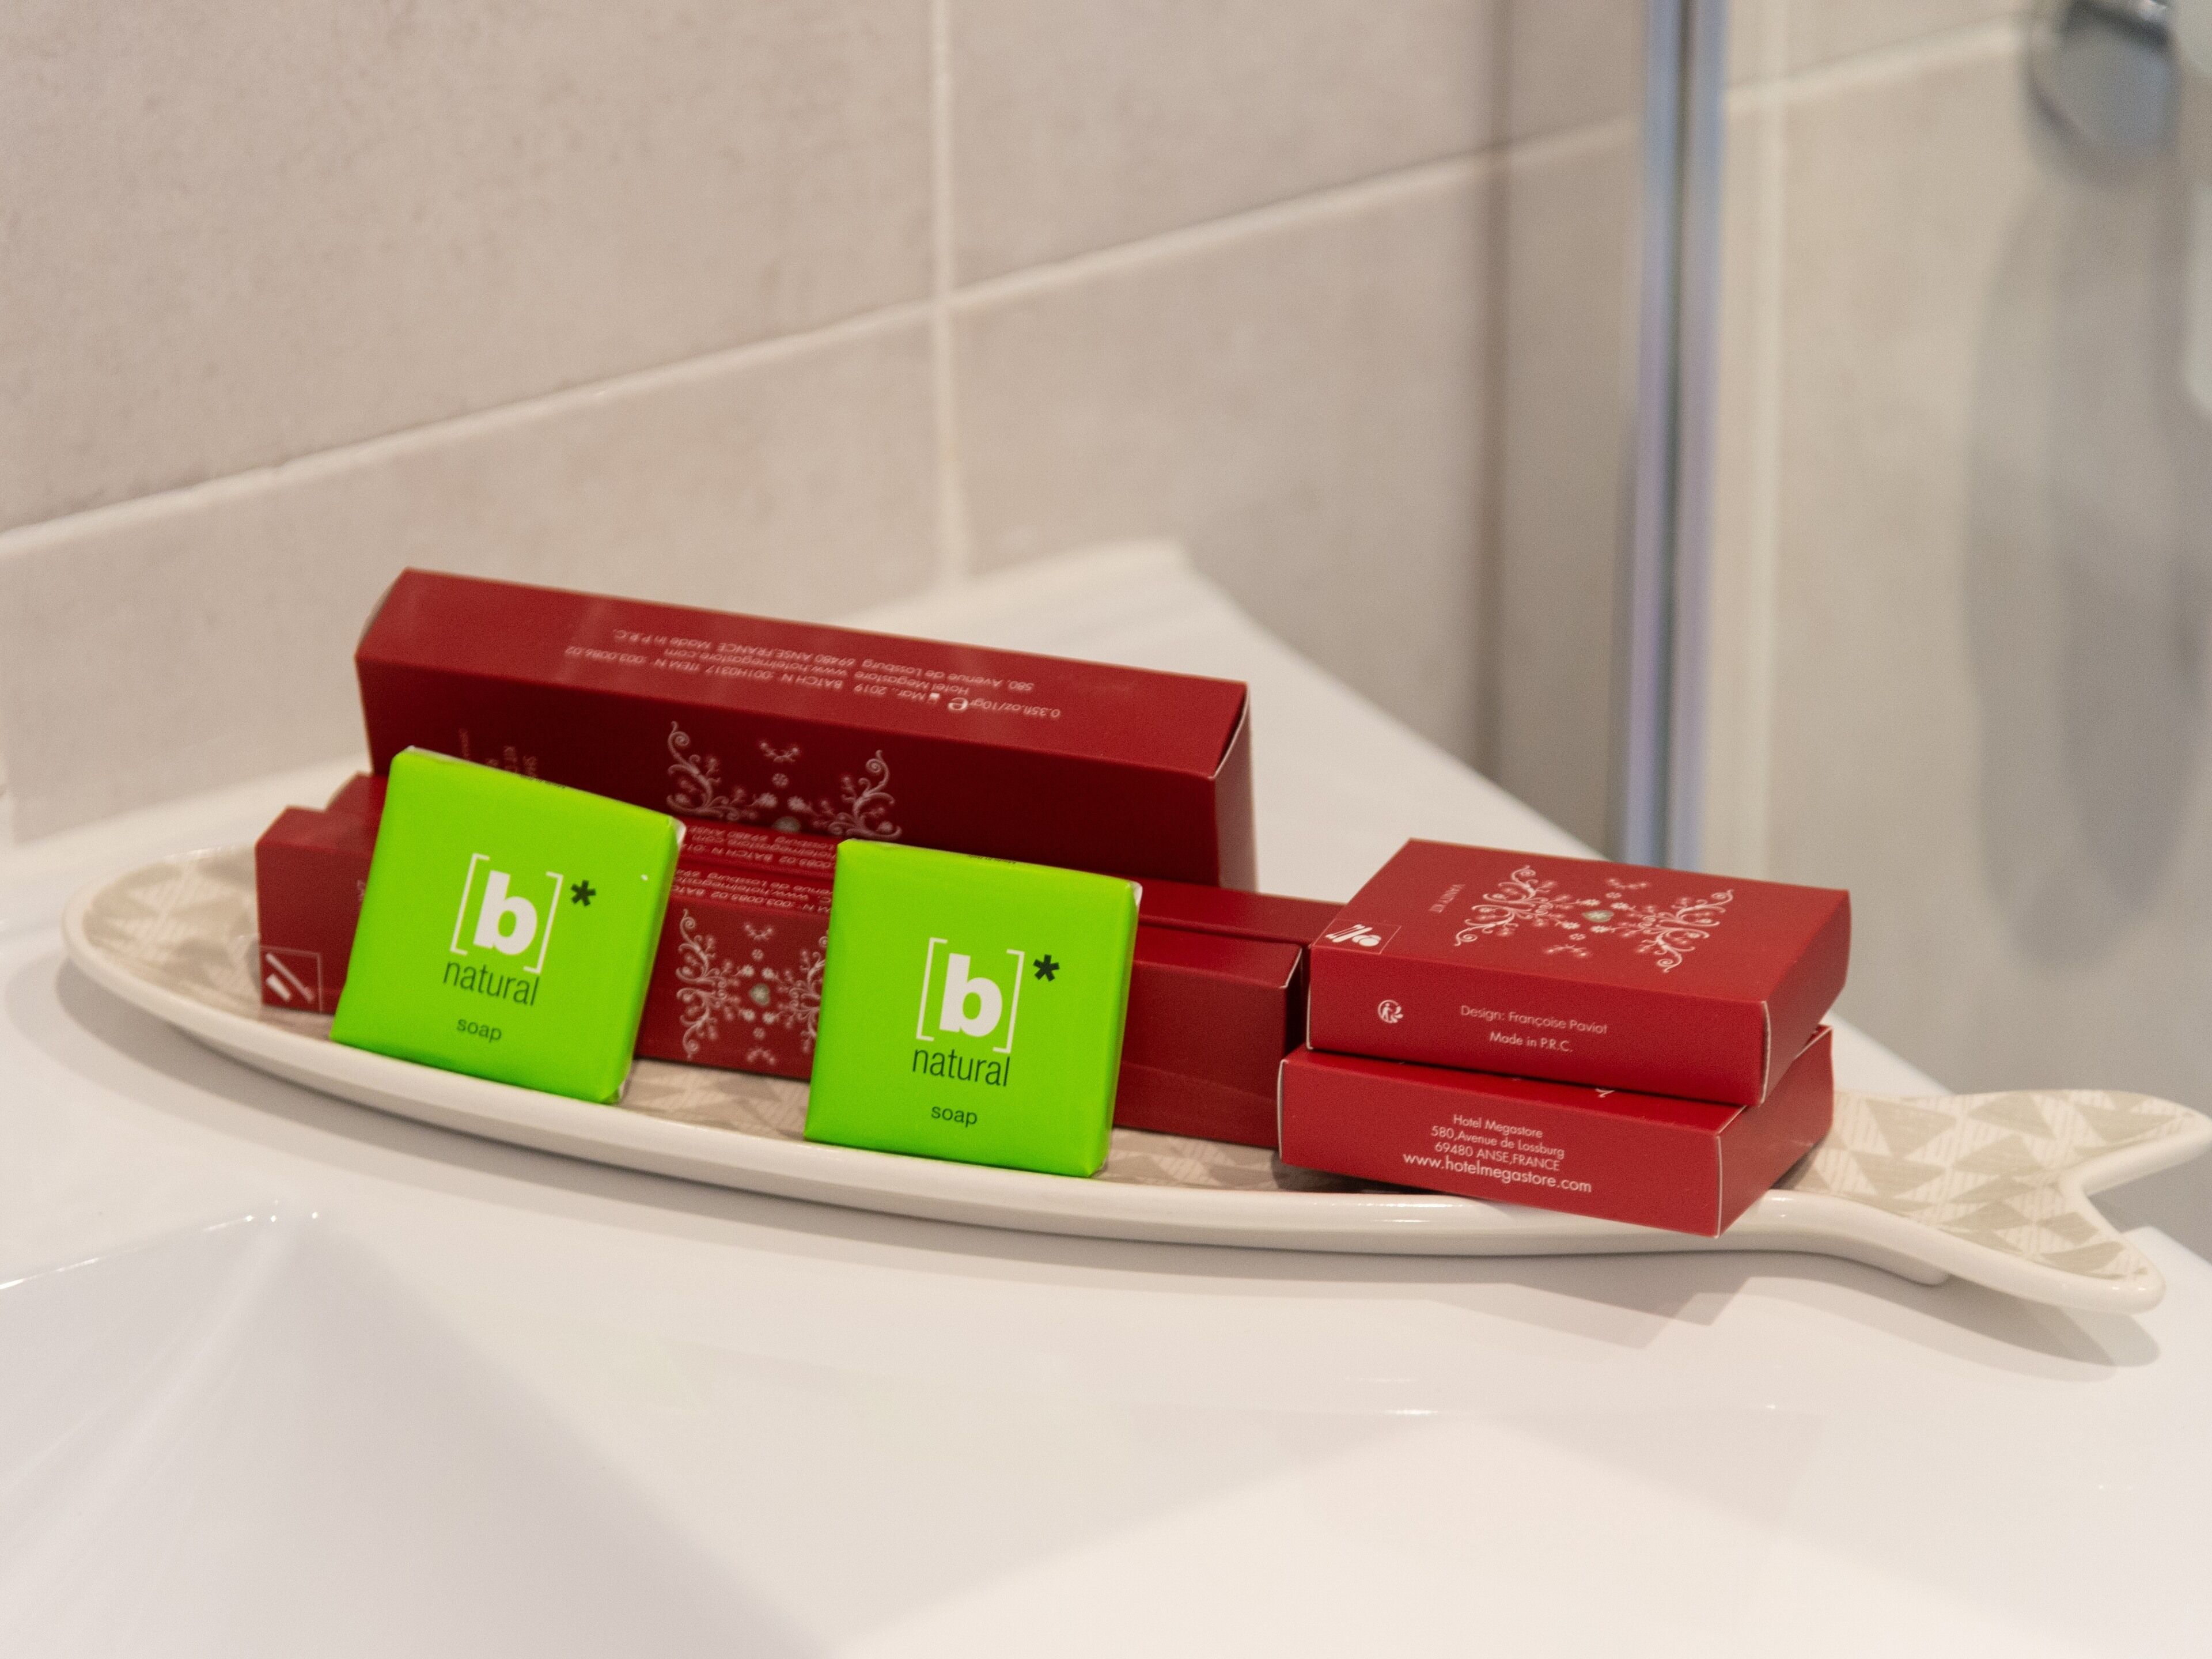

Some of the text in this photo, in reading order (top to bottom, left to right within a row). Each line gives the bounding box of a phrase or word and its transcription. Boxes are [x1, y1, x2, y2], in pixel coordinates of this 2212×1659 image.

[653, 636, 666, 646] in
[669, 638, 713, 650] Made
[815, 654, 856, 668] 69480
[862, 658, 923, 677] Lossburg
[796, 675, 843, 690] BATCH
[854, 671, 928, 690] Megastore
[924, 669, 945, 680] de
[946, 673, 1001, 688] Avenue
[853, 683, 887, 695] 2019
[932, 683, 969, 695] Hotel
[442, 960, 540, 1006] natural
[1460, 1005, 1608, 1035] Design: Françoise Paviot
[456, 1017, 502, 1043] soap
[1490, 1031, 1523, 1047] Made
[1527, 1036, 1537, 1047] in
[912, 1048, 1011, 1087] natural
[930, 1105, 978, 1128] soap
[1453, 1113, 1543, 1138] Hotel Megastore
[1434, 1142, 1474, 1157] 69480
[1500, 1137, 1515, 1149] de
[1517, 1139, 1566, 1160] Lossburg
[1402, 1153, 1593, 1194] www.hotelmegastore.com
